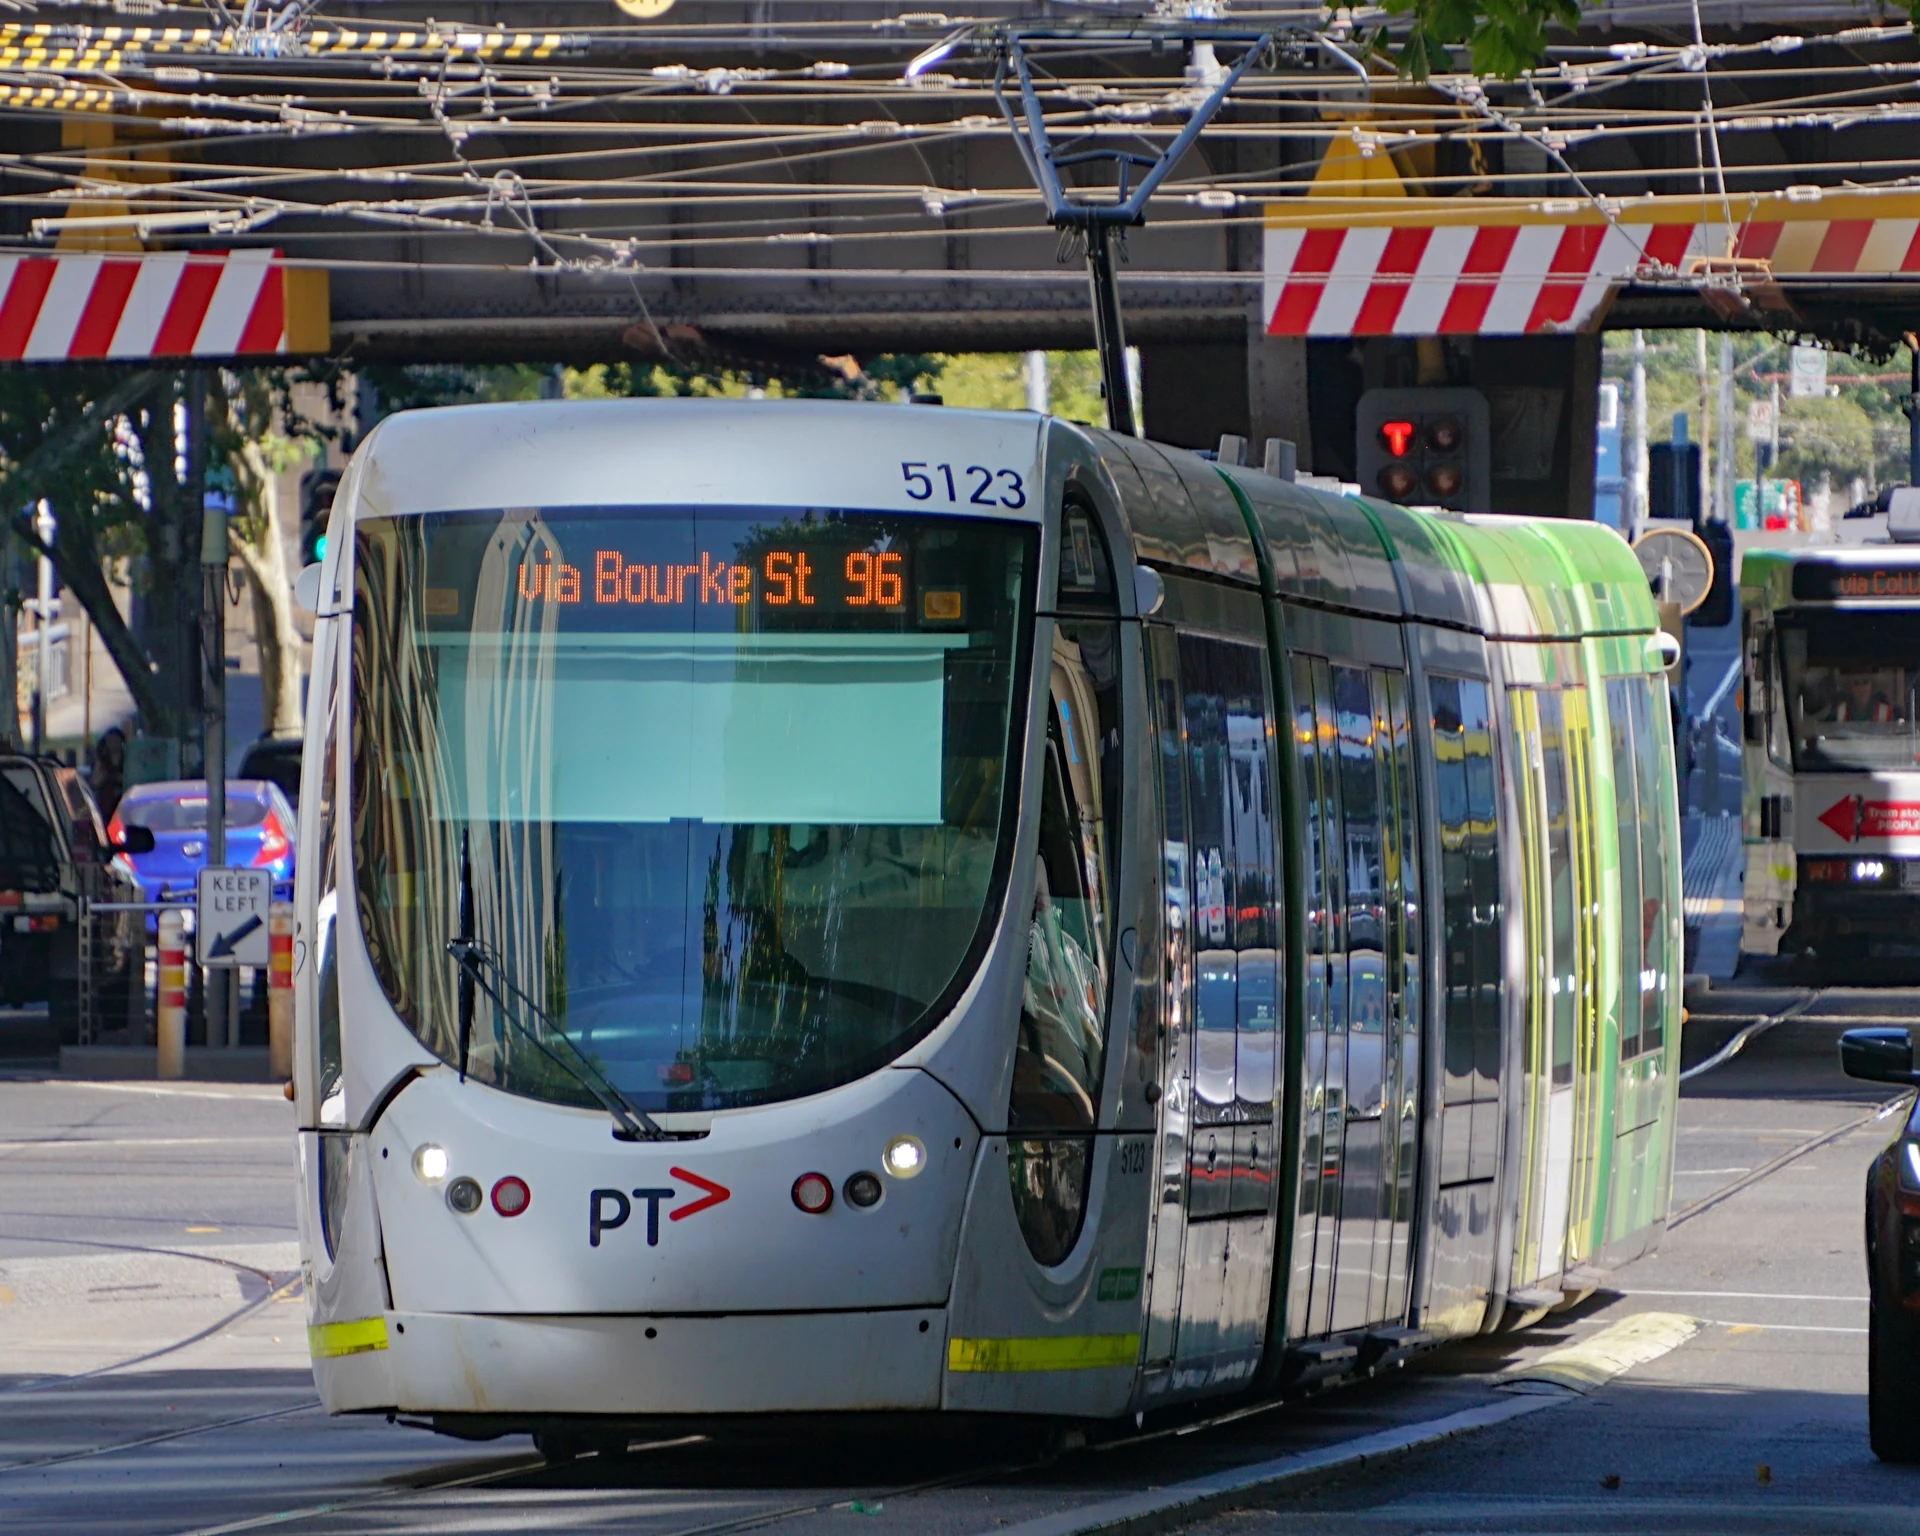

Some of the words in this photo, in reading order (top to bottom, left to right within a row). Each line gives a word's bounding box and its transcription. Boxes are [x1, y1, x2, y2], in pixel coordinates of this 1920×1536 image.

[901, 461, 1027, 510] 5123
[518, 551, 581, 603] via
[596, 551, 750, 603] Bourke
[766, 552, 815, 604] St
[846, 552, 902, 604] 96
[1839, 573, 1868, 594] via
[1869, 807, 1899, 818] Tram
[213, 876, 260, 891] KEEP
[215, 896, 258, 911] LEFT
[1121, 1142, 1146, 1175] 5123
